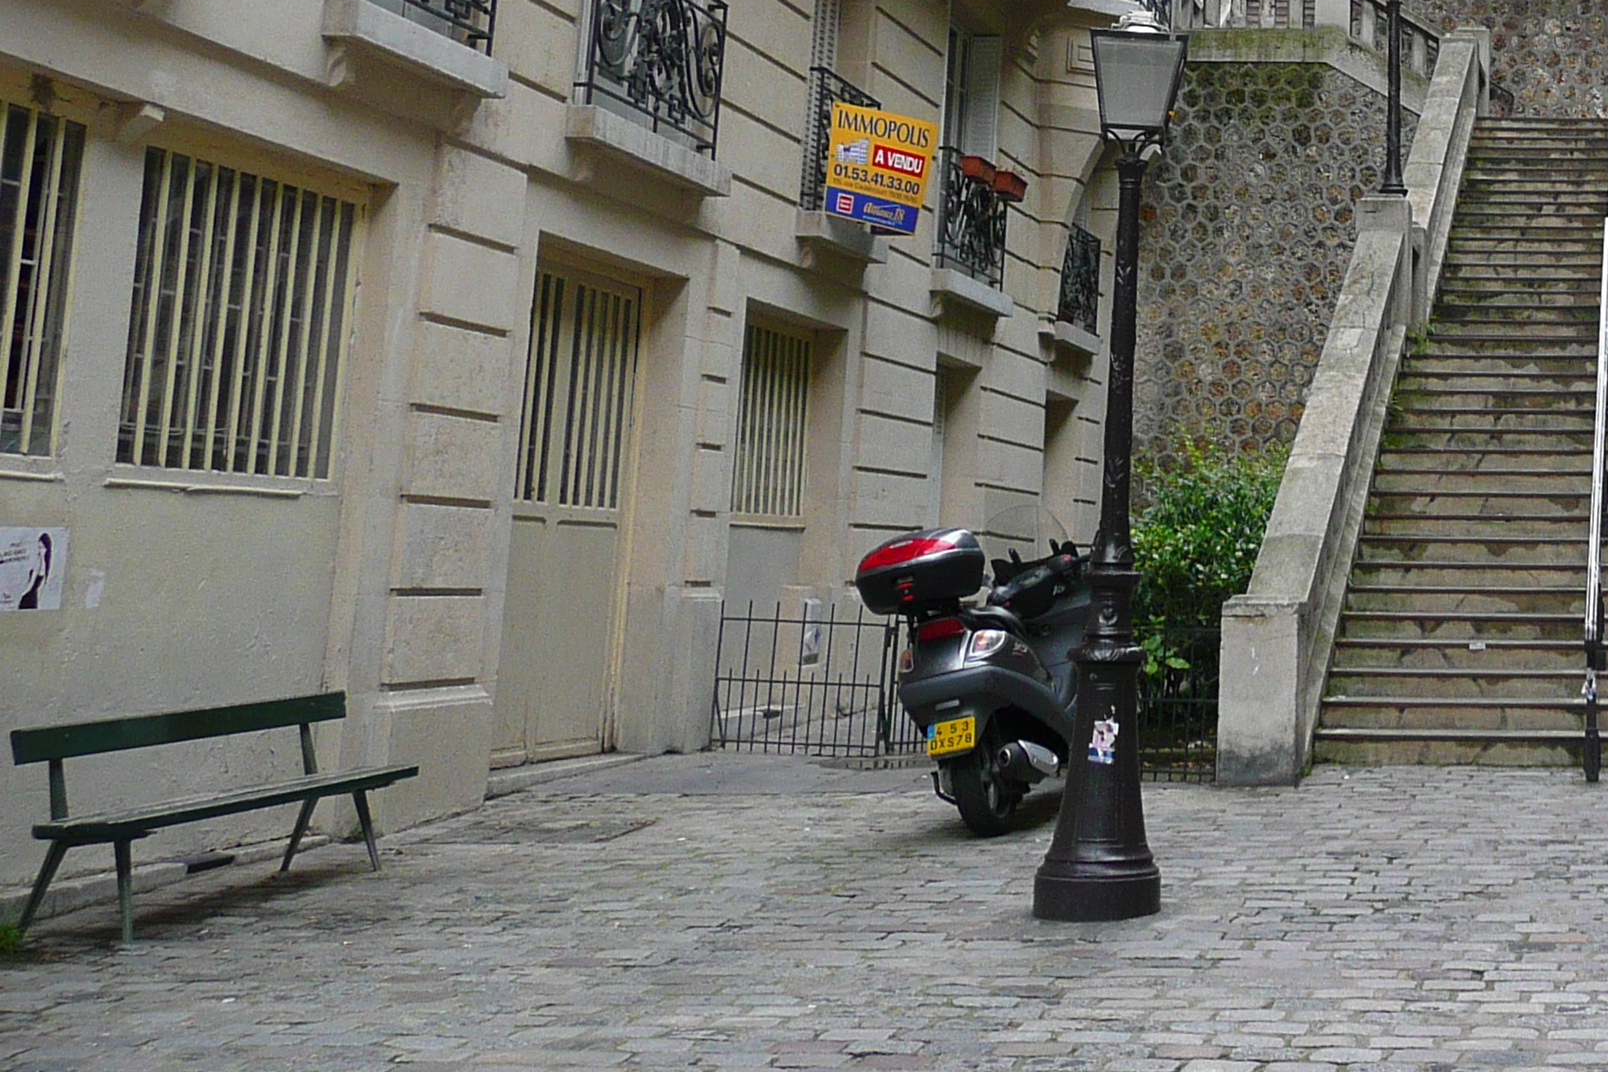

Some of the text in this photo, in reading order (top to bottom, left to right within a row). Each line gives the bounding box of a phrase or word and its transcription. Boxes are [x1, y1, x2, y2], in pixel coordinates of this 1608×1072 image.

[838, 109, 930, 148] IMMOPOLIS
[875, 149, 923, 173] A VENDU
[834, 164, 920, 195] 01.53.41.33.00
